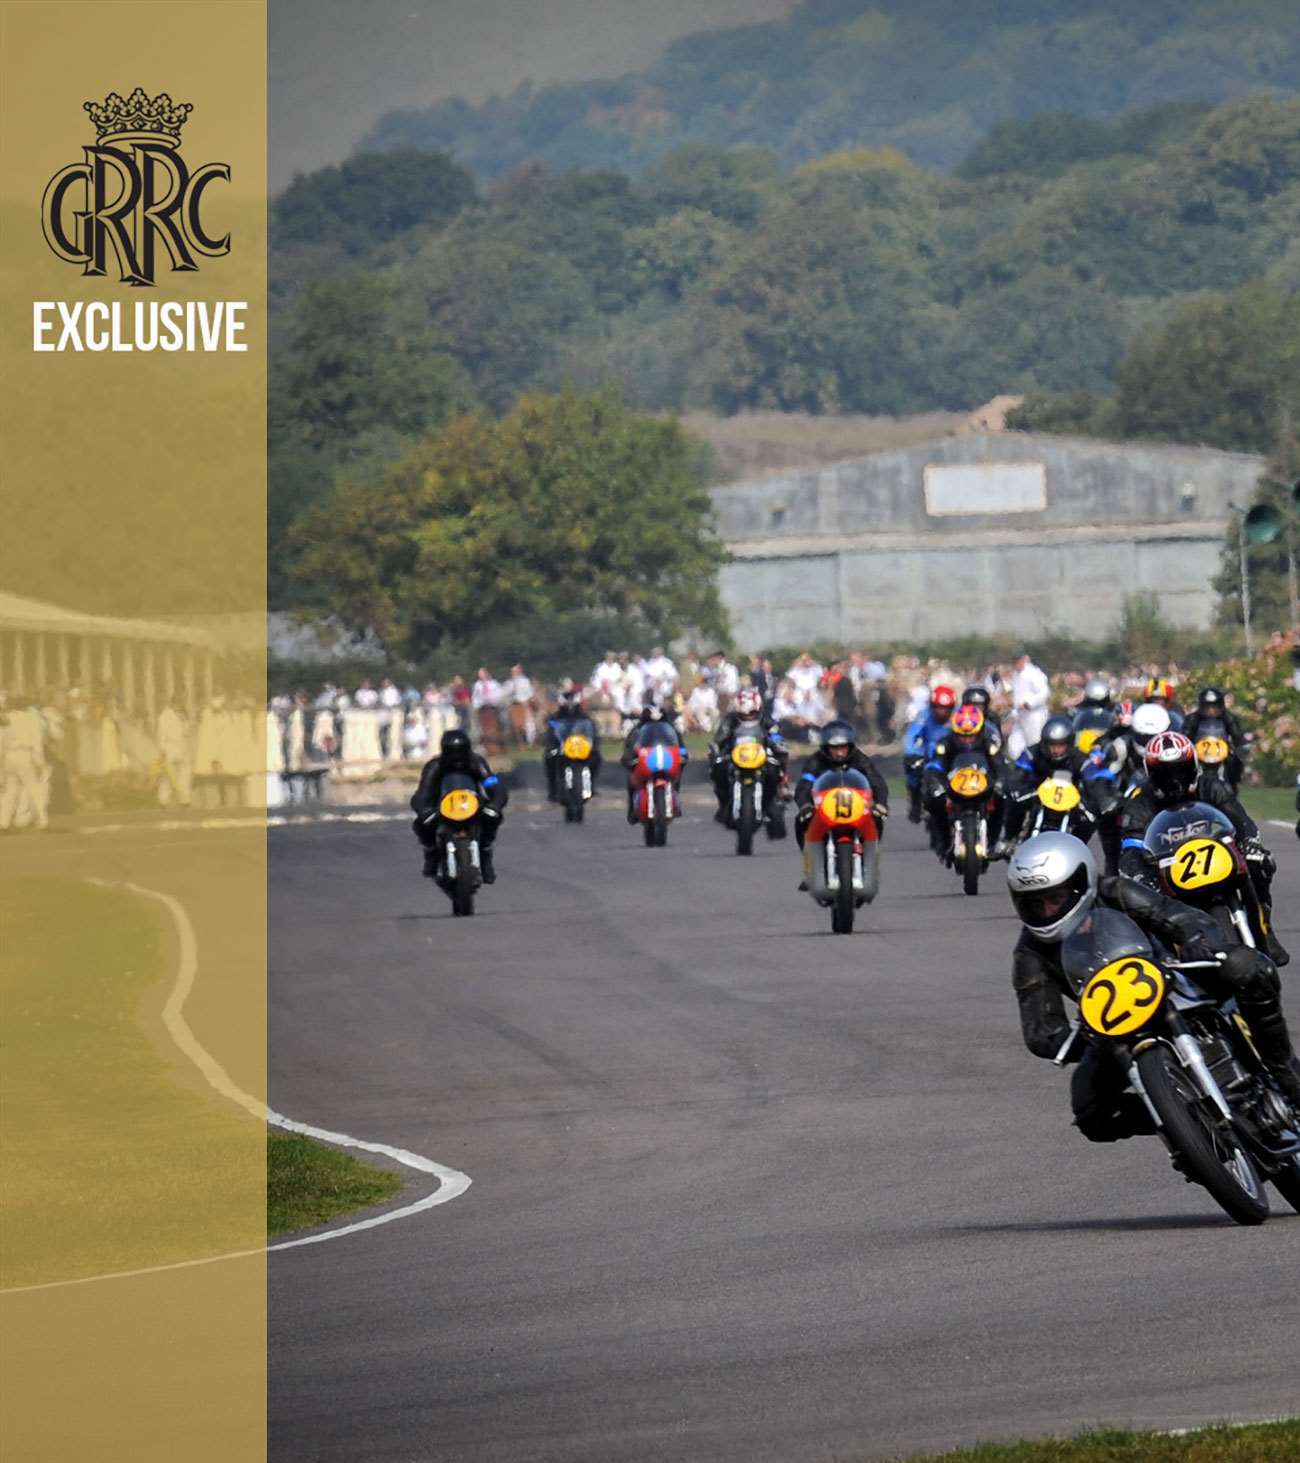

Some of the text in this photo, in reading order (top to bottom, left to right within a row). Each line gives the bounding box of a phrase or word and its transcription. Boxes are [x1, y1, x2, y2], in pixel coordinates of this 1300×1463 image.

[832, 790, 854, 819] 19
[1053, 785, 1064, 805] 5
[1179, 843, 1217, 883] 27
[1086, 960, 1159, 1033] 23
